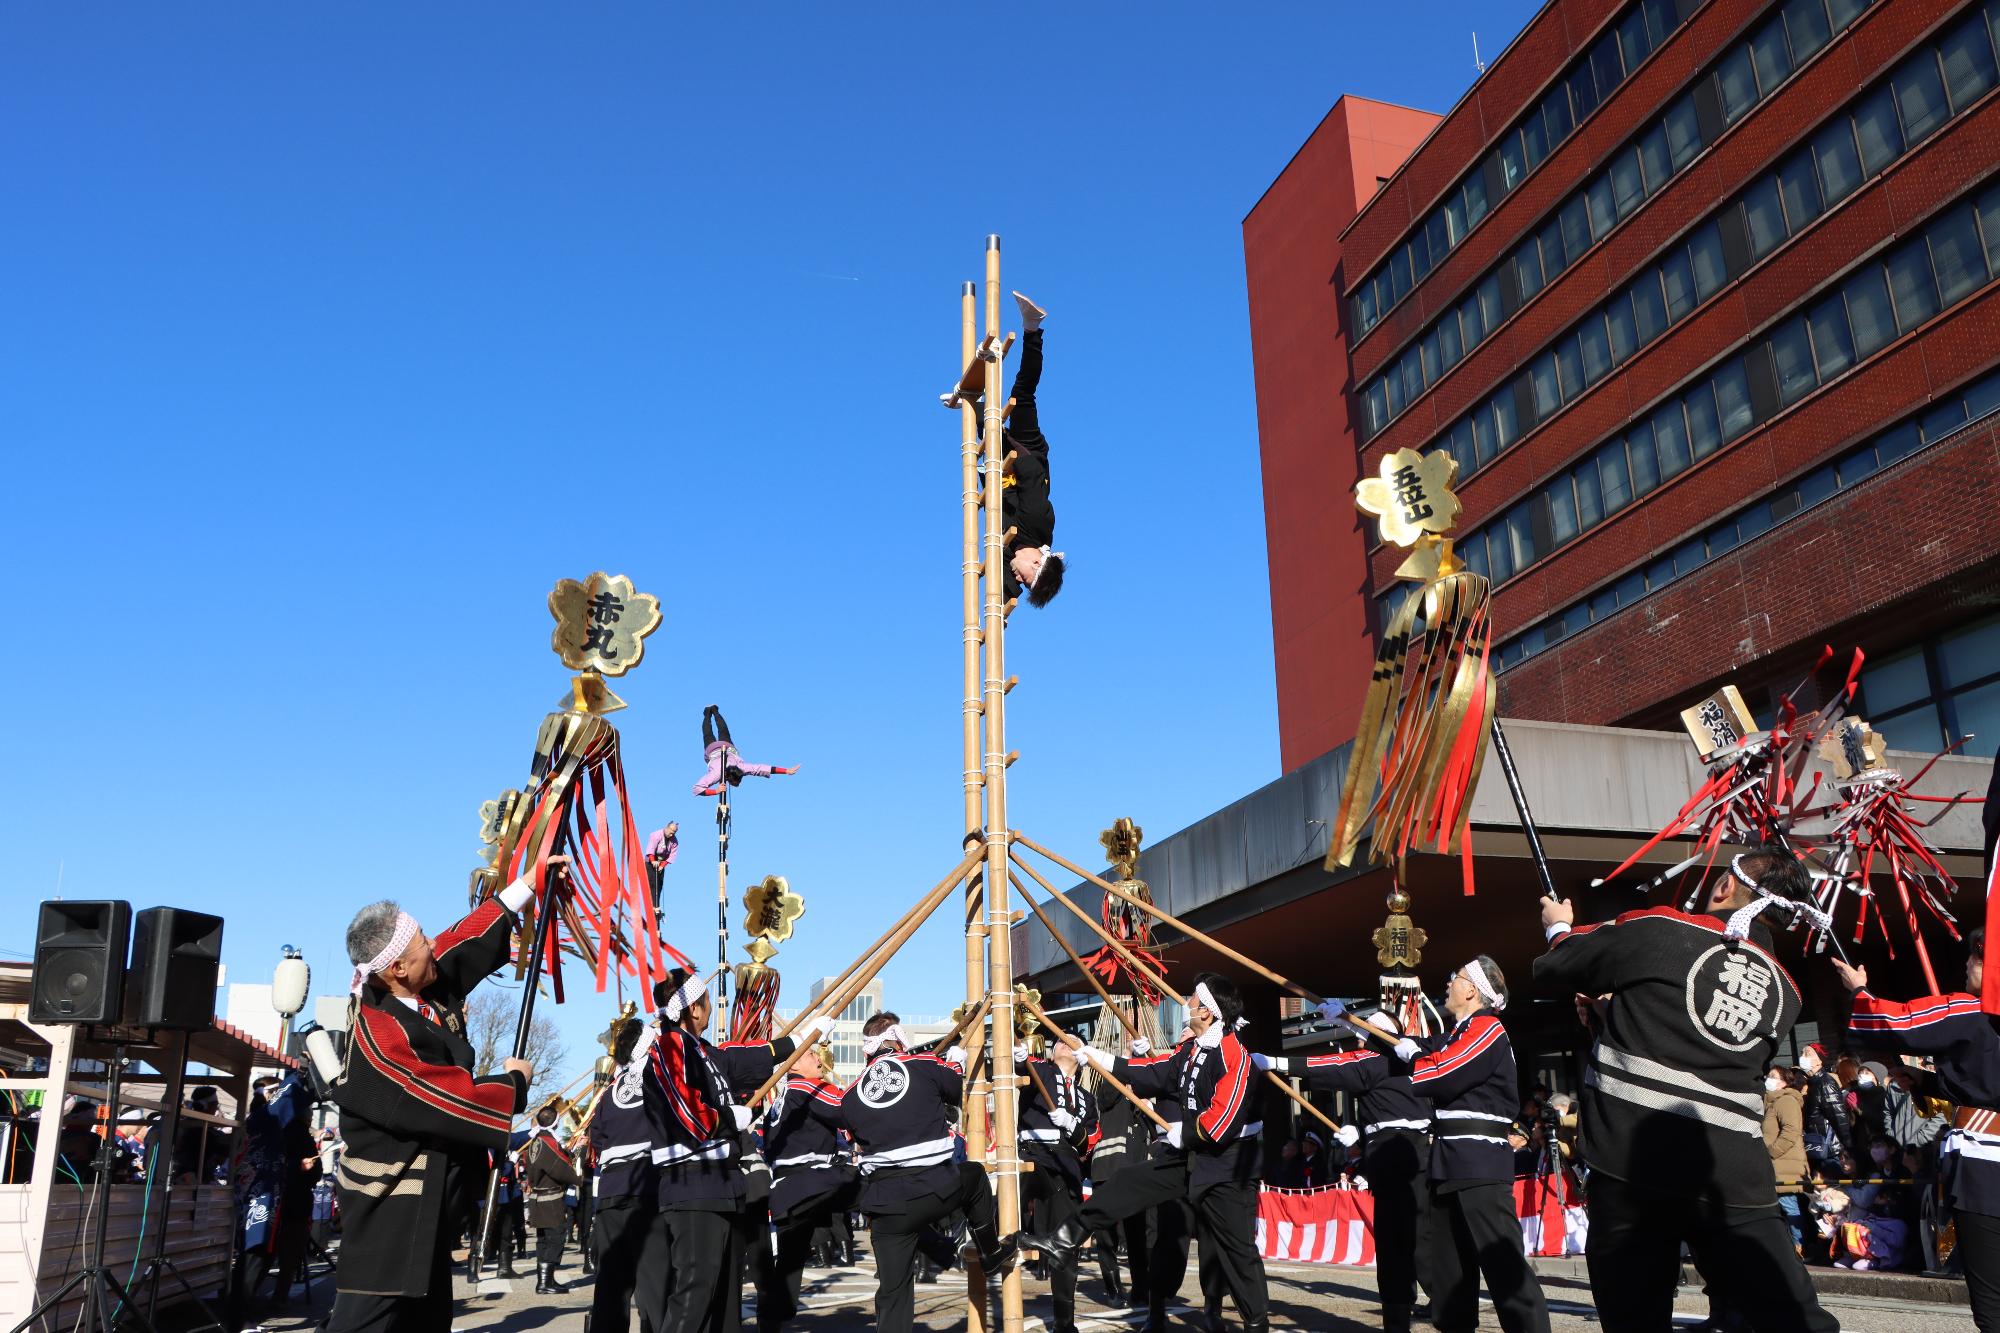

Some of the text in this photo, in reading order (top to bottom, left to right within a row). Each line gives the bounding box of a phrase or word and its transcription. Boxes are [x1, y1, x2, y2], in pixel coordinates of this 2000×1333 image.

[1391, 464, 1434, 525] 五位山
[580, 591, 625, 660] 赤丸
[1391, 927, 1408, 959] 福岡
[1704, 952, 1772, 1042] 福岡
